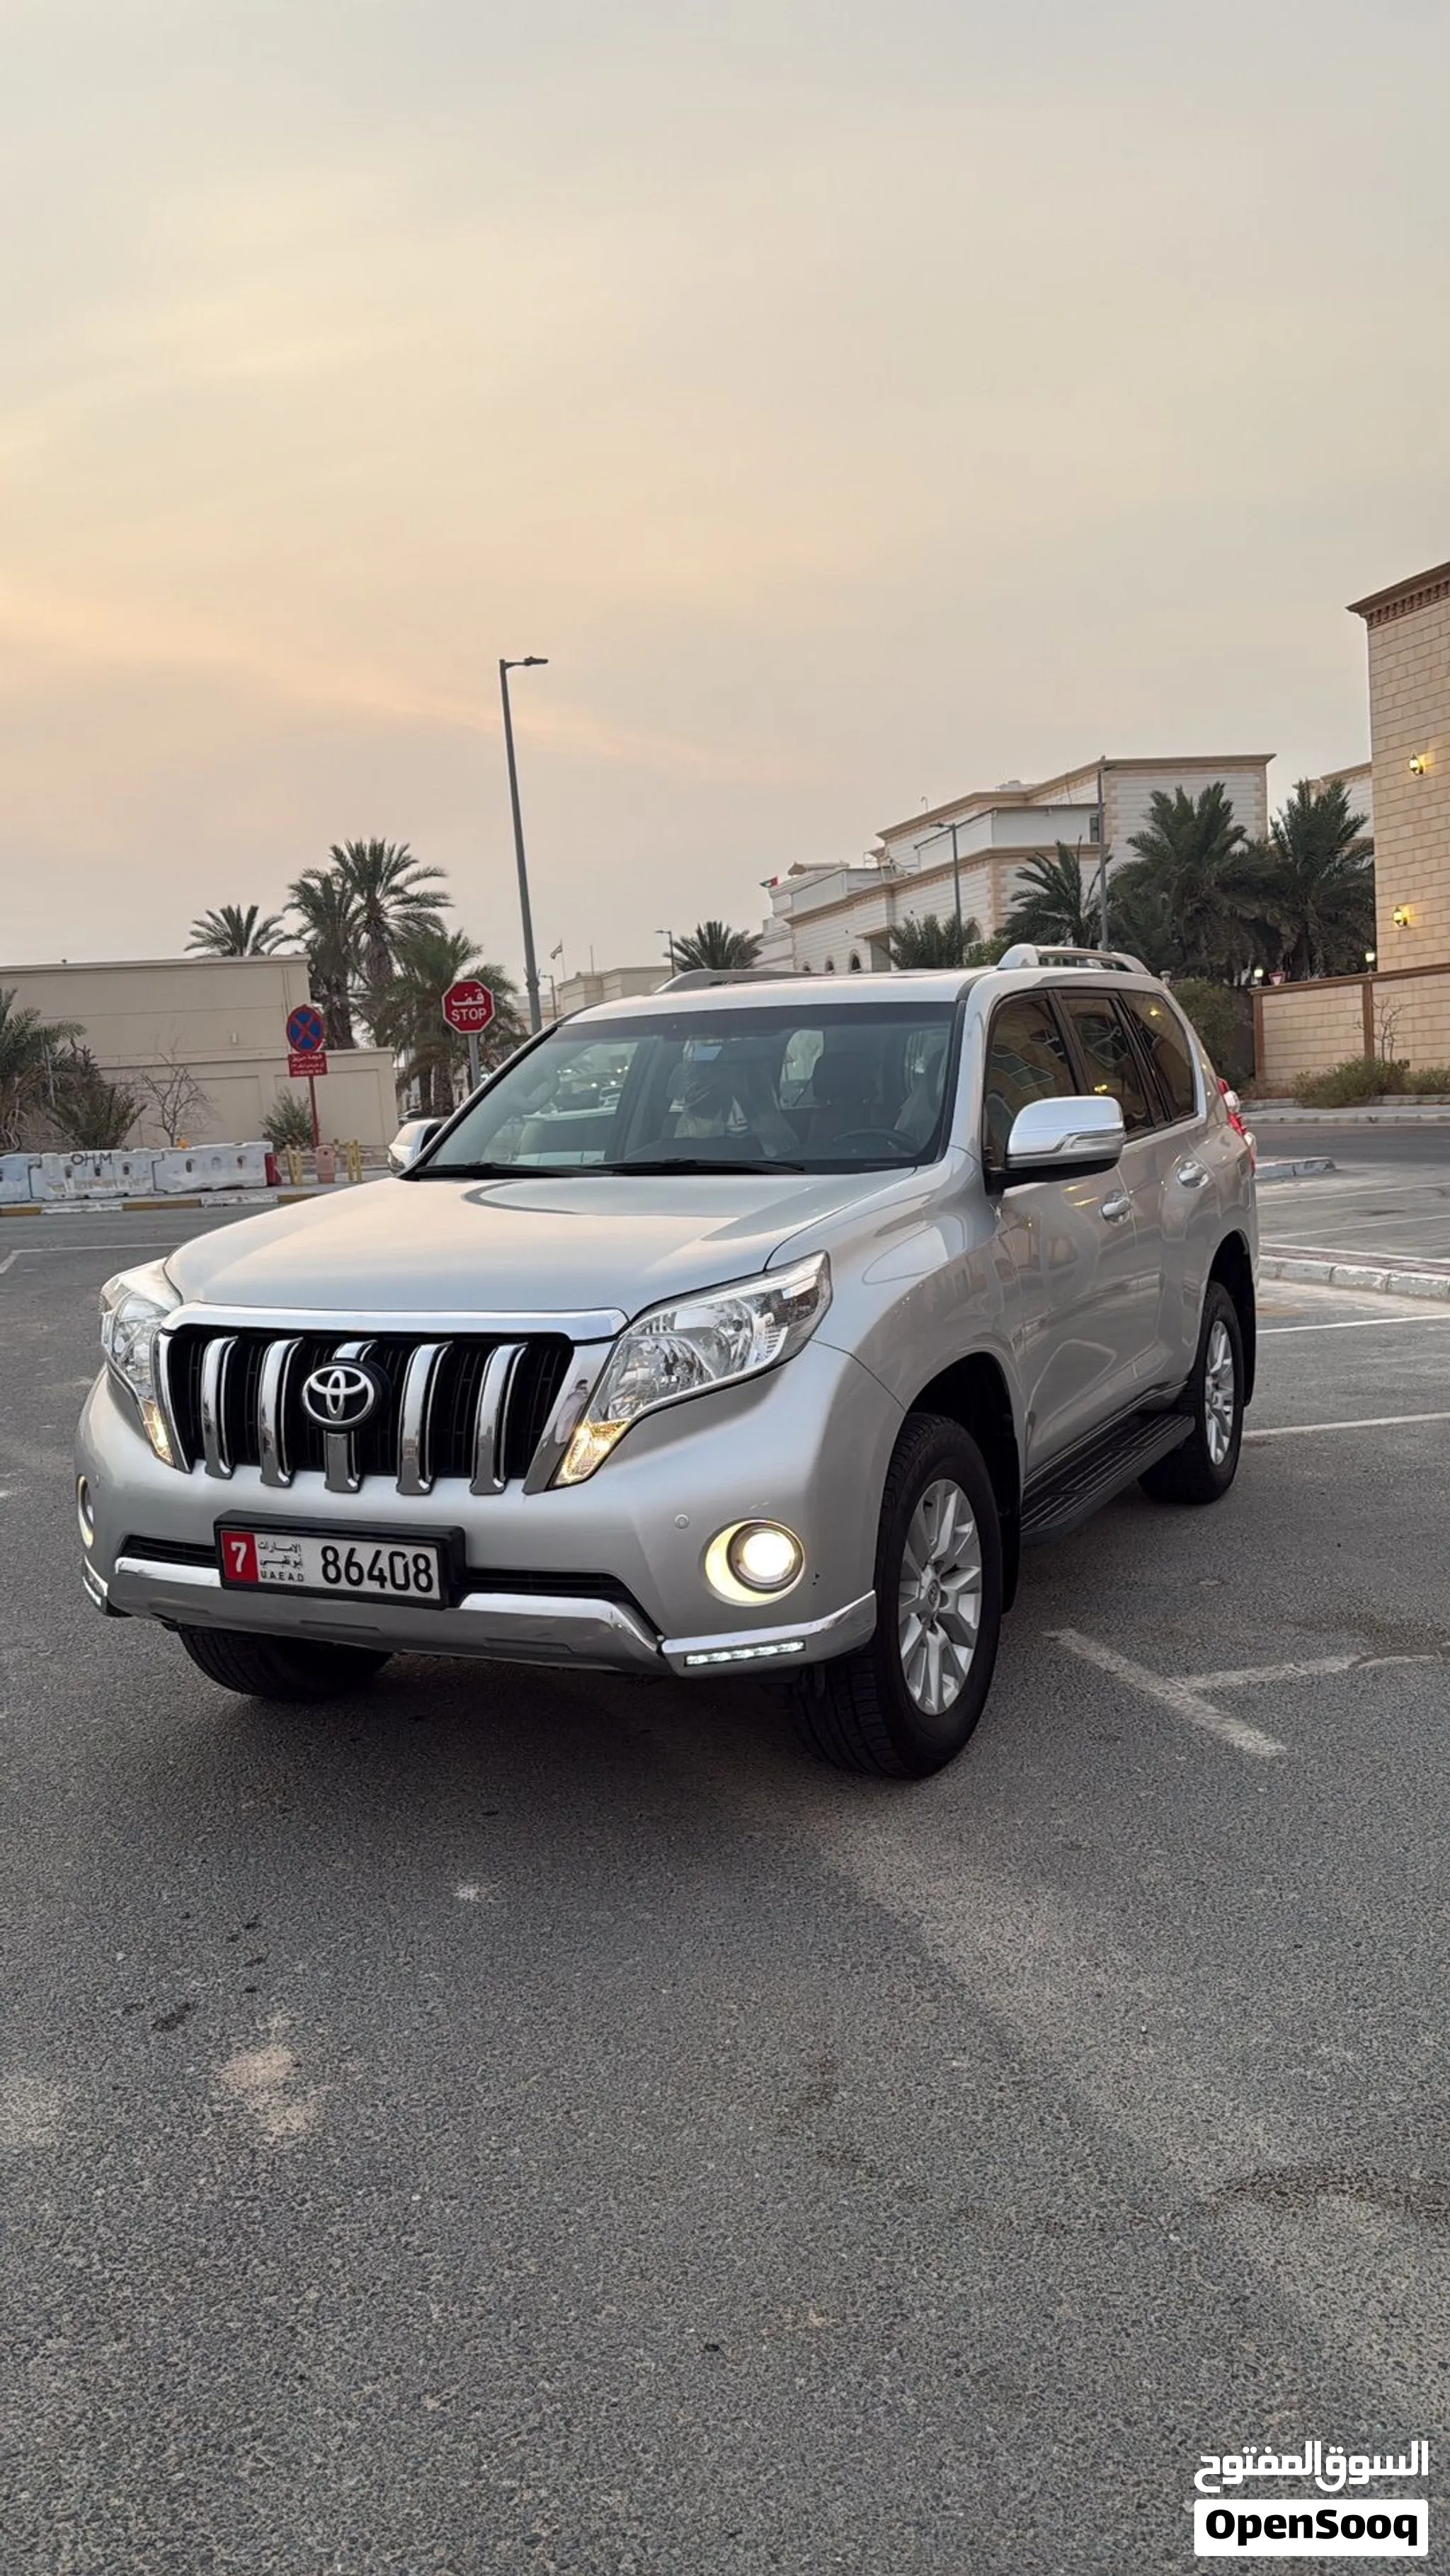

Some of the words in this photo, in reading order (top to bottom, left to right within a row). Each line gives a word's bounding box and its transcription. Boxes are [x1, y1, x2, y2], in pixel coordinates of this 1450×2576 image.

[451, 988, 485, 1006] قف
[451, 1008, 487, 1021] STOP
[231, 1542, 247, 1573] 7
[321, 1545, 433, 1593] 86408
